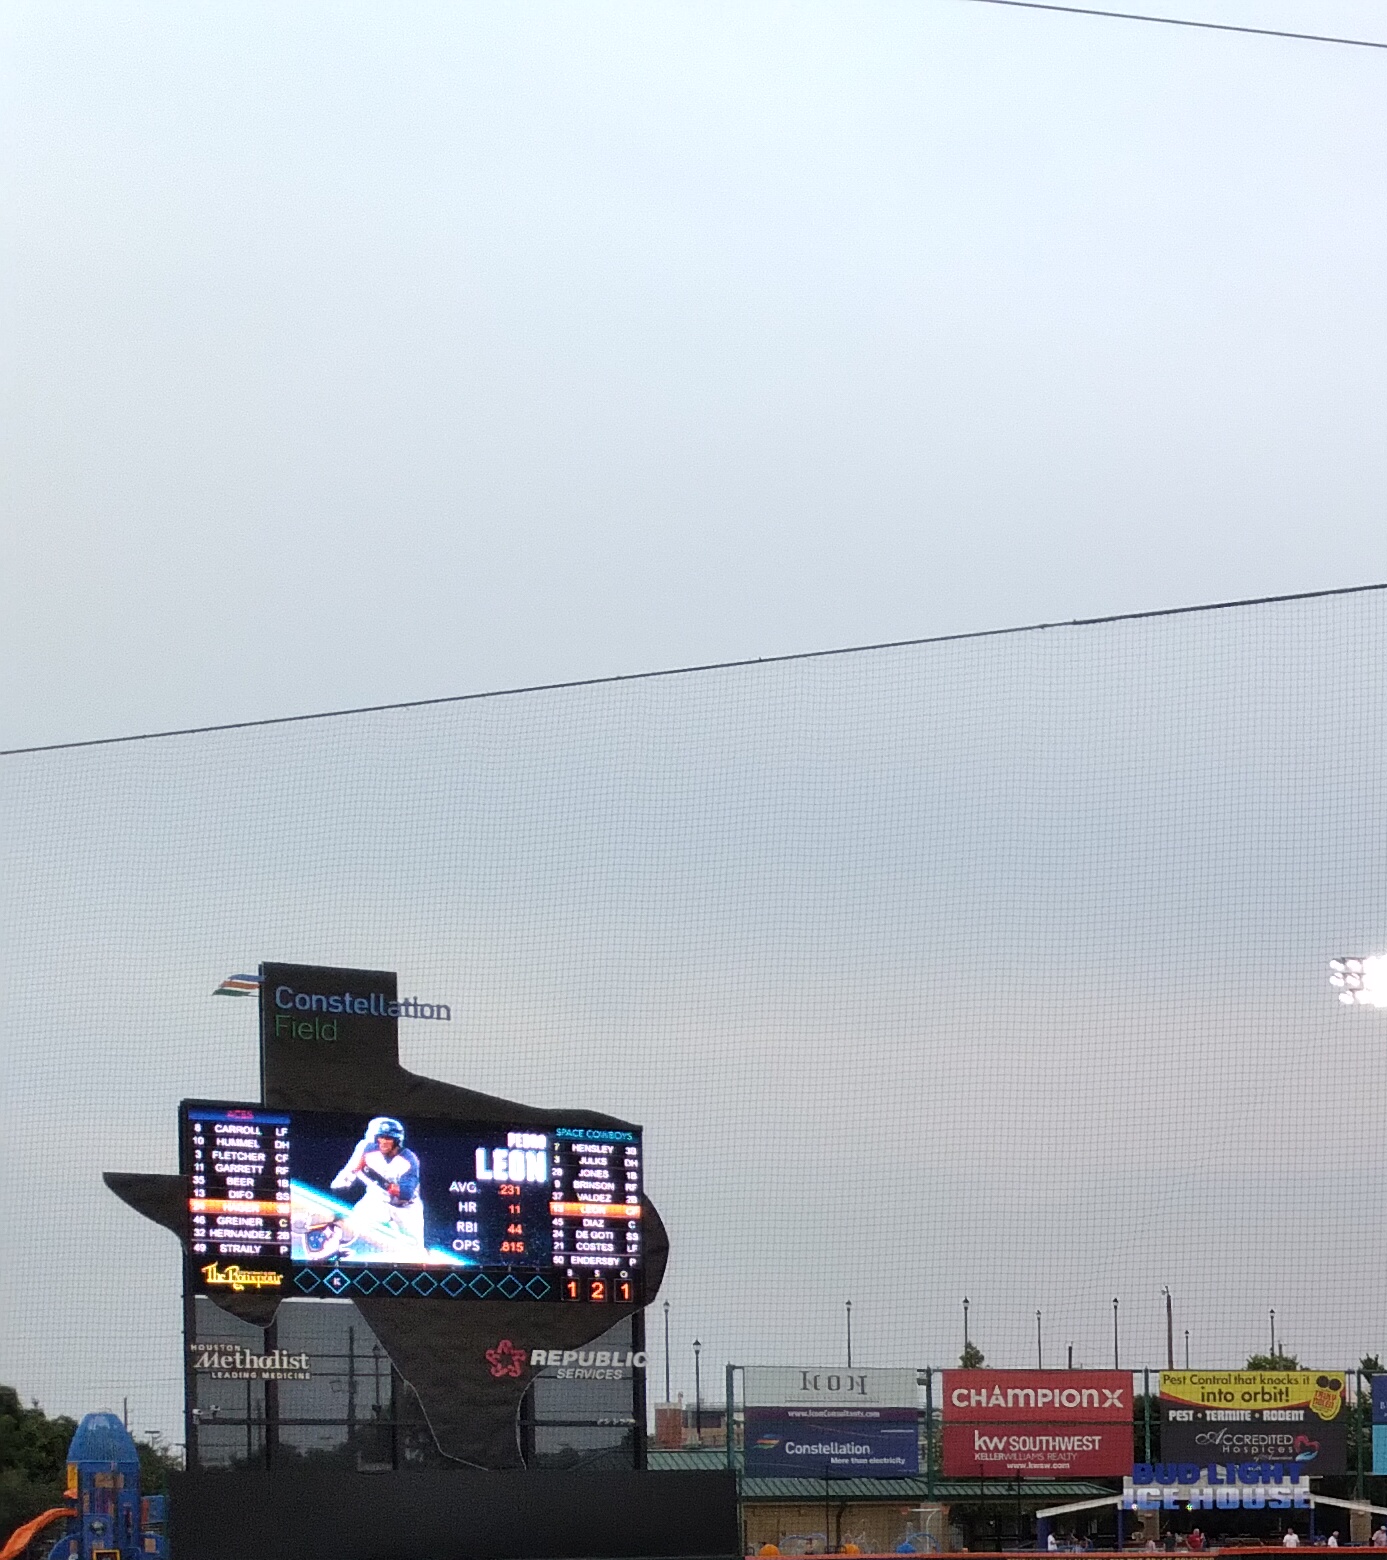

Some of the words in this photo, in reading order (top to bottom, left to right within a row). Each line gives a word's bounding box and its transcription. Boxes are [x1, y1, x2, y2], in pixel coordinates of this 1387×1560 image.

[274, 985, 451, 1021] Constellation
[274, 1014, 339, 1042] Field
[214, 1124, 261, 1134] CARROLL
[556, 1128, 585, 1138] SPACE
[586, 1130, 633, 1140] COWBOYS
[216, 1138, 260, 1148] HUMMEL
[572, 1144, 614, 1154] HENSLEY
[212, 1151, 266, 1162] FLETCHER
[215, 1164, 264, 1174] GARRETT
[476, 1148, 547, 1182] LEON
[578, 1169, 609, 1179] JONES
[226, 1178, 254, 1186] BEER
[573, 1181, 615, 1191] BRINSON
[228, 1190, 254, 1200] DIFO
[498, 1185, 521, 1196] .231
[577, 1192, 612, 1203] VALDEZ
[458, 1202, 477, 1213] HR
[508, 1205, 521, 1214] 11
[217, 1216, 263, 1226] GREINER
[582, 1218, 605, 1228] DIAZ
[456, 1221, 478, 1233] RBI
[507, 1225, 523, 1235] 44
[210, 1230, 272, 1239] HERNANDEZ
[220, 1244, 261, 1254] STRAILY
[452, 1239, 480, 1252] OPS
[500, 1242, 524, 1253] .815
[576, 1242, 614, 1252] COSTES
[570, 1256, 620, 1266] ENDERSBY
[567, 1281, 578, 1298] 1
[591, 1282, 604, 1299] 2
[620, 1283, 629, 1300] 1
[193, 1349, 310, 1369] Methodist
[530, 1349, 649, 1368] REPUBLIC
[262, 1372, 310, 1380] MEDICINE
[556, 1368, 623, 1380] SERVICES
[1163, 1374, 1186, 1385] Pest
[1190, 1374, 1232, 1385] Control
[1234, 1374, 1258, 1385] that
[1260, 1374, 1298, 1385] knocks
[1302, 1375, 1310, 1385] it
[1201, 1386, 1234, 1402] into
[1241, 1386, 1290, 1402] orbit!
[1168, 1410, 1194, 1422] PEST
[1205, 1410, 1252, 1422] TERMITE
[1263, 1410, 1304, 1421] RODENT
[974, 1430, 1007, 1450] kw
[1009, 1436, 1102, 1450] SOUTHWEST
[1196, 1427, 1294, 1446] ACCREDITED
[785, 1442, 870, 1454] Constellation
[1222, 1446, 1294, 1454] Hospices
[869, 1457, 906, 1466] electricity
[1047, 1452, 1078, 1460] REALTY
[1132, 1463, 1201, 1484] BUD
[1208, 1462, 1306, 1484] LIGHT
[1123, 1488, 1180, 1510] ICE
[1190, 1488, 1312, 1510] HOUSE
